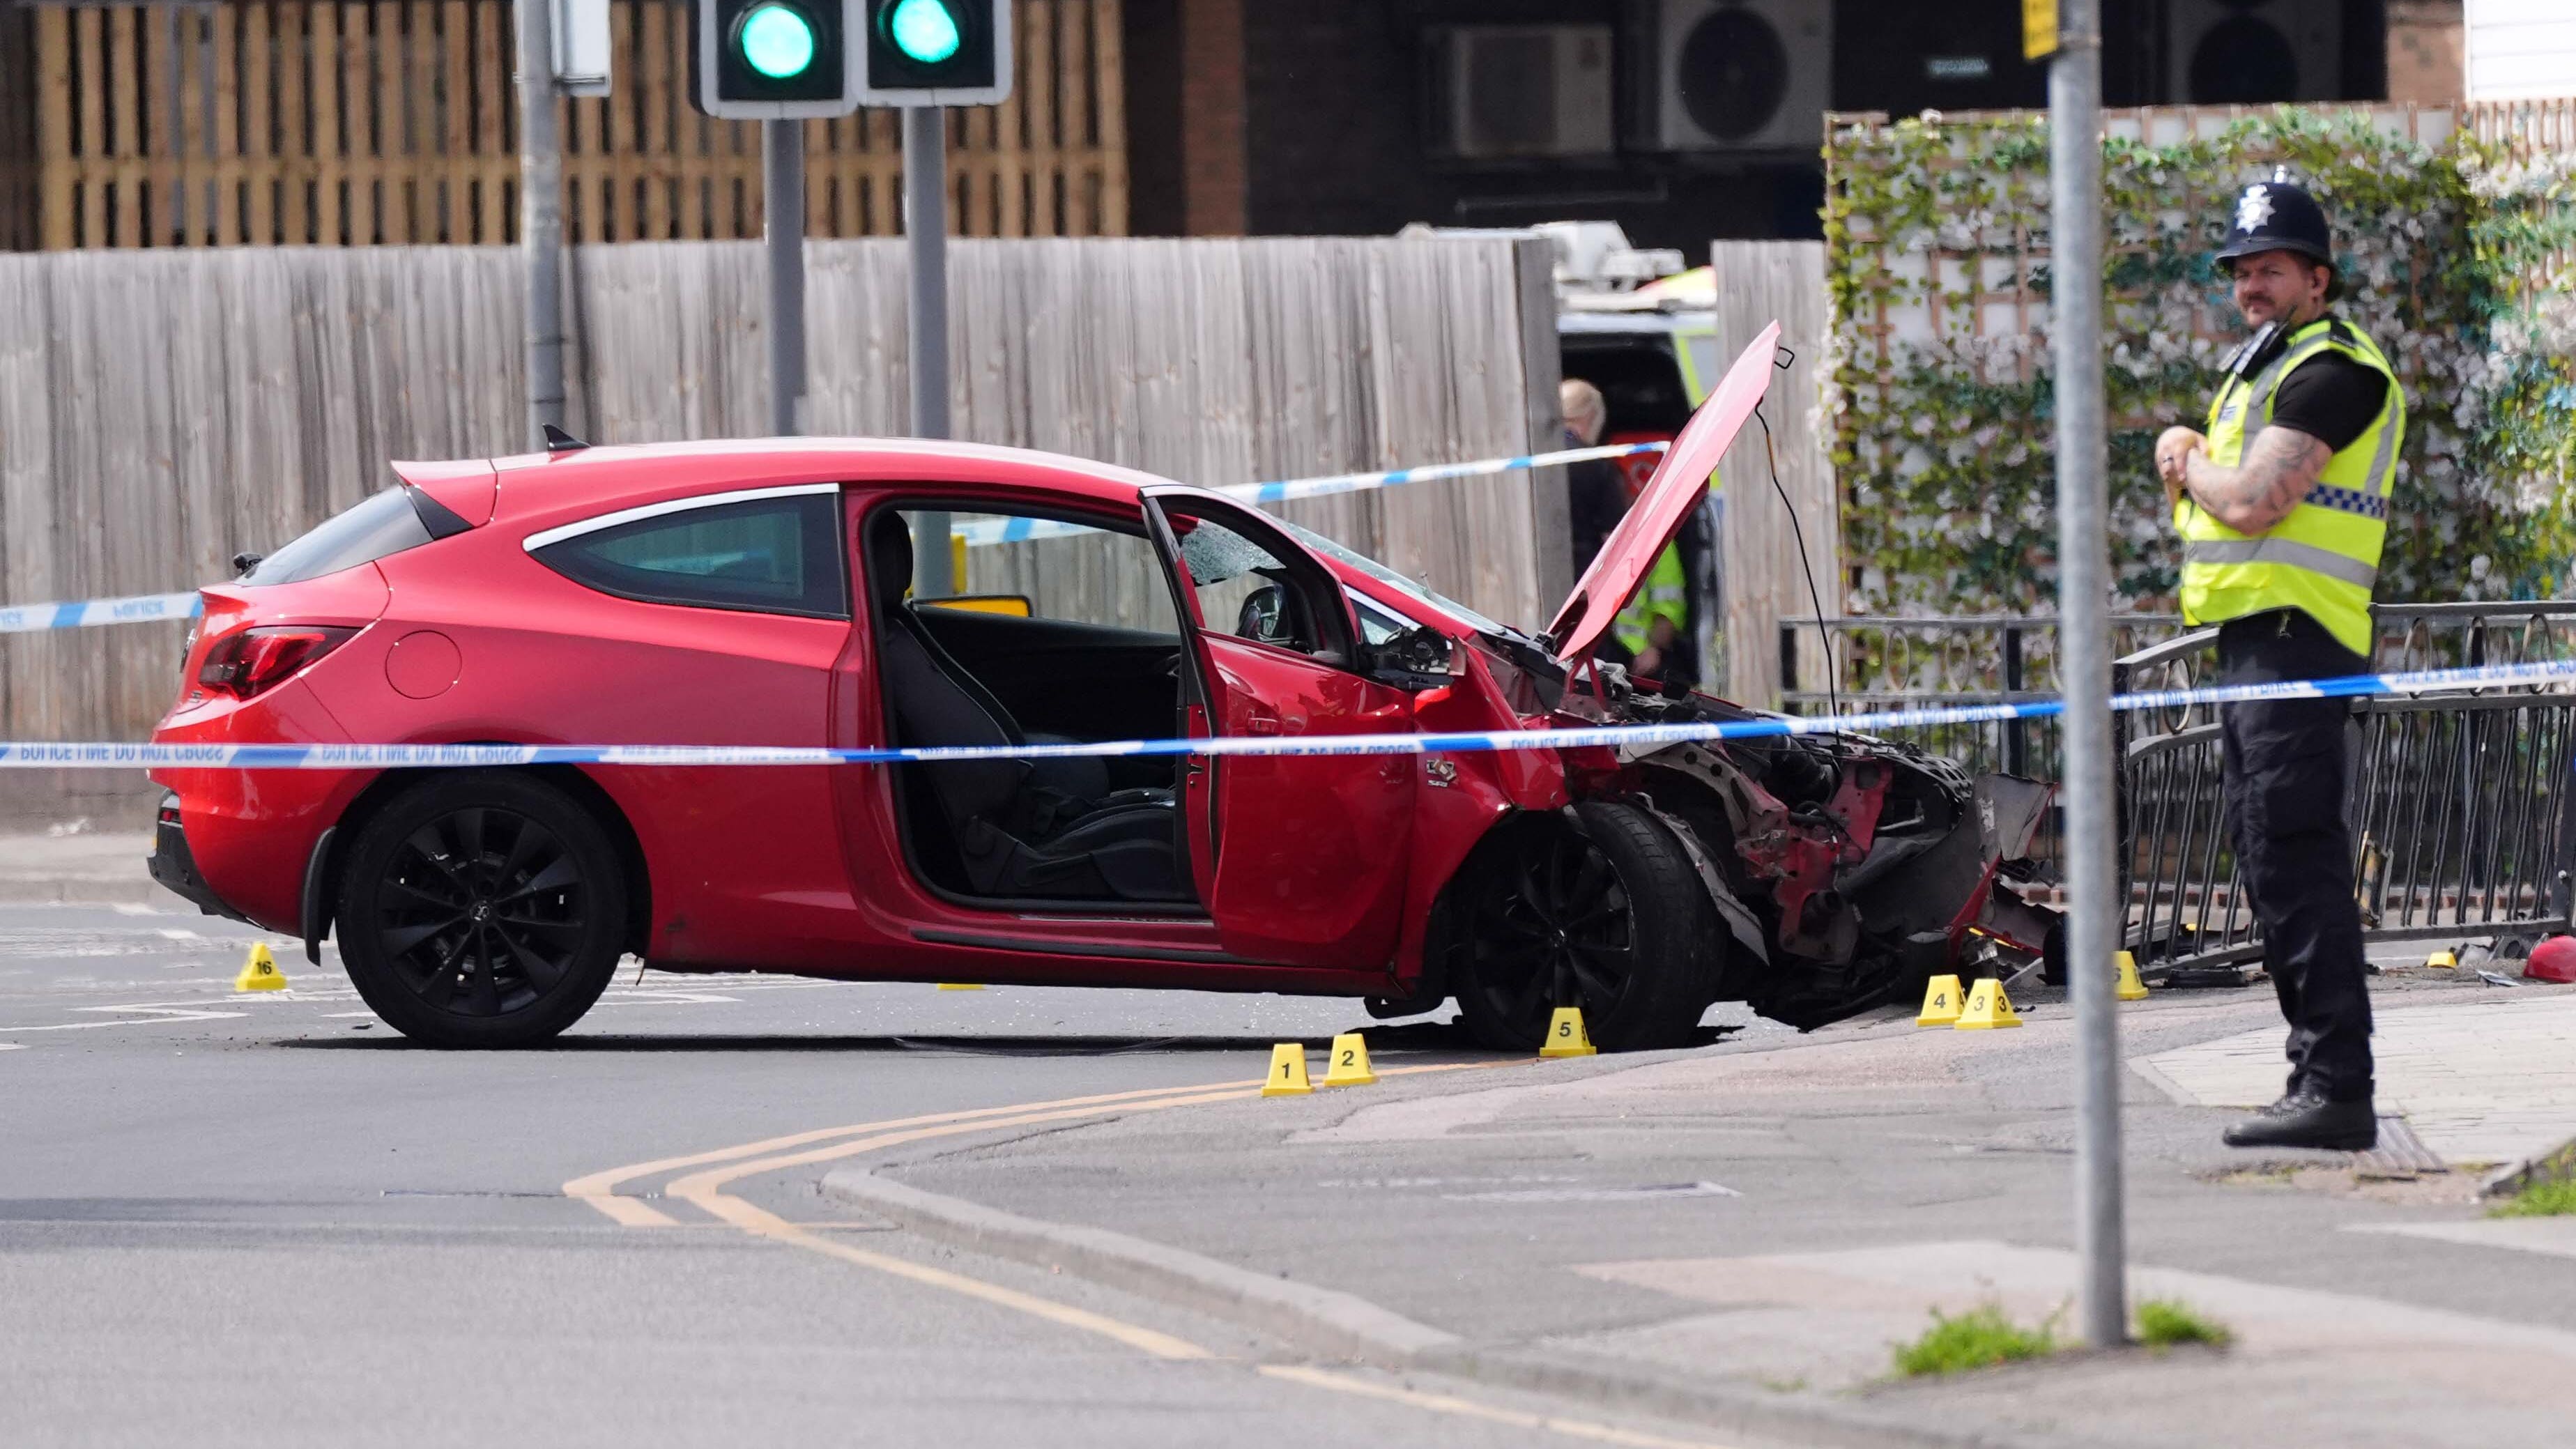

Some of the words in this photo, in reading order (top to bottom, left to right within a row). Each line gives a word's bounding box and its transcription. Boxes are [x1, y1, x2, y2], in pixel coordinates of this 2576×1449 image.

[256, 960, 272, 975] 16
[1934, 992, 1946, 1009] 4
[1974, 995, 1985, 1011] 3
[1998, 996, 2007, 1012] 3
[1559, 1022, 1572, 1037] 5
[1342, 1050, 1354, 1066] 2
[1282, 1063, 1290, 1079] 1
